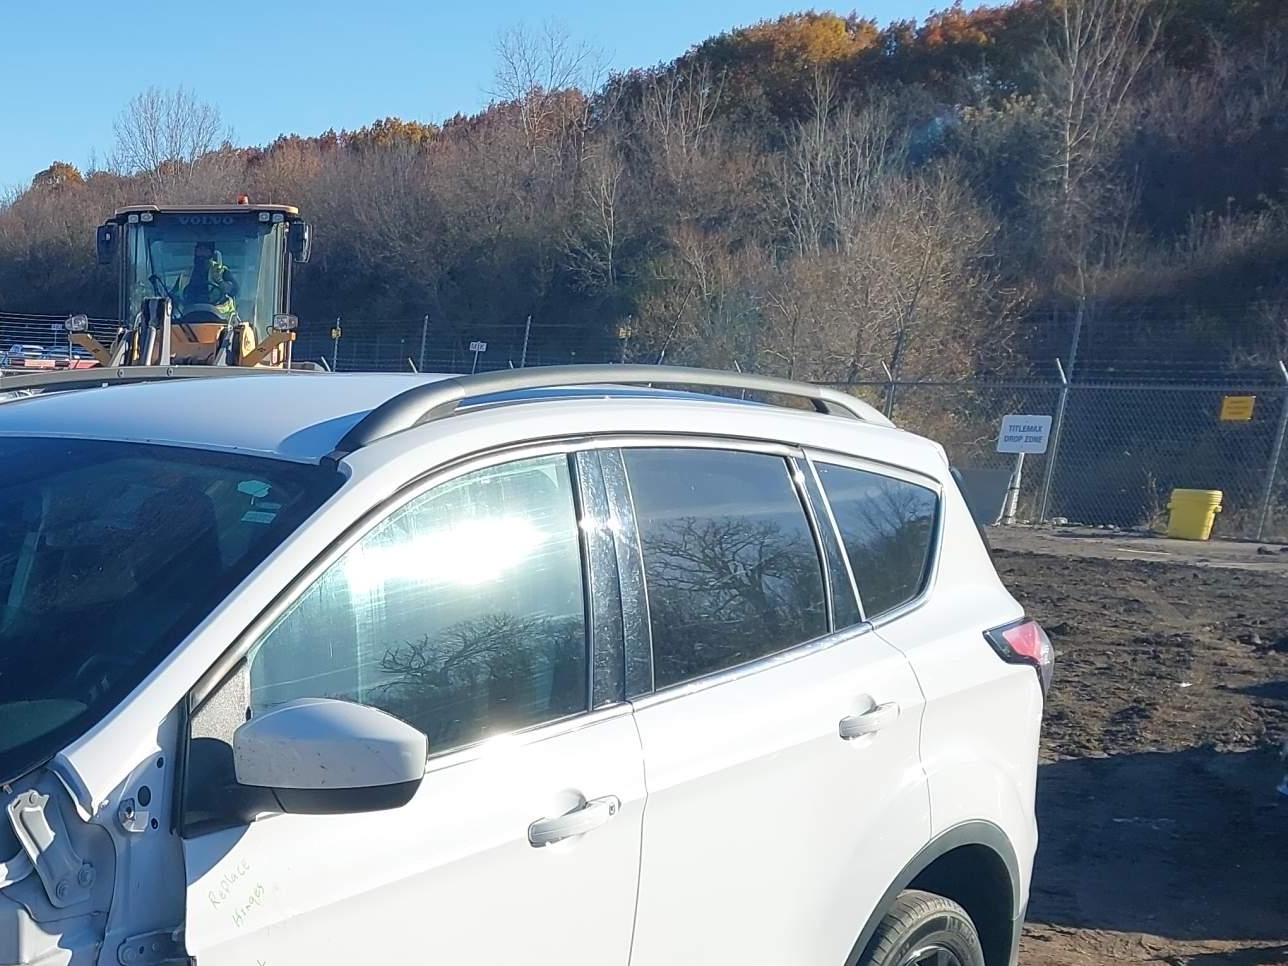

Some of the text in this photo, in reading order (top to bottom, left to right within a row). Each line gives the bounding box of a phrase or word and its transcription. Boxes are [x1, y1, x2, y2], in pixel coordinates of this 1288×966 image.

[179, 215, 233, 225] VOLVO
[1009, 424, 1043, 433] TITLEMAX
[1004, 435, 1043, 443] DROP ZONE
